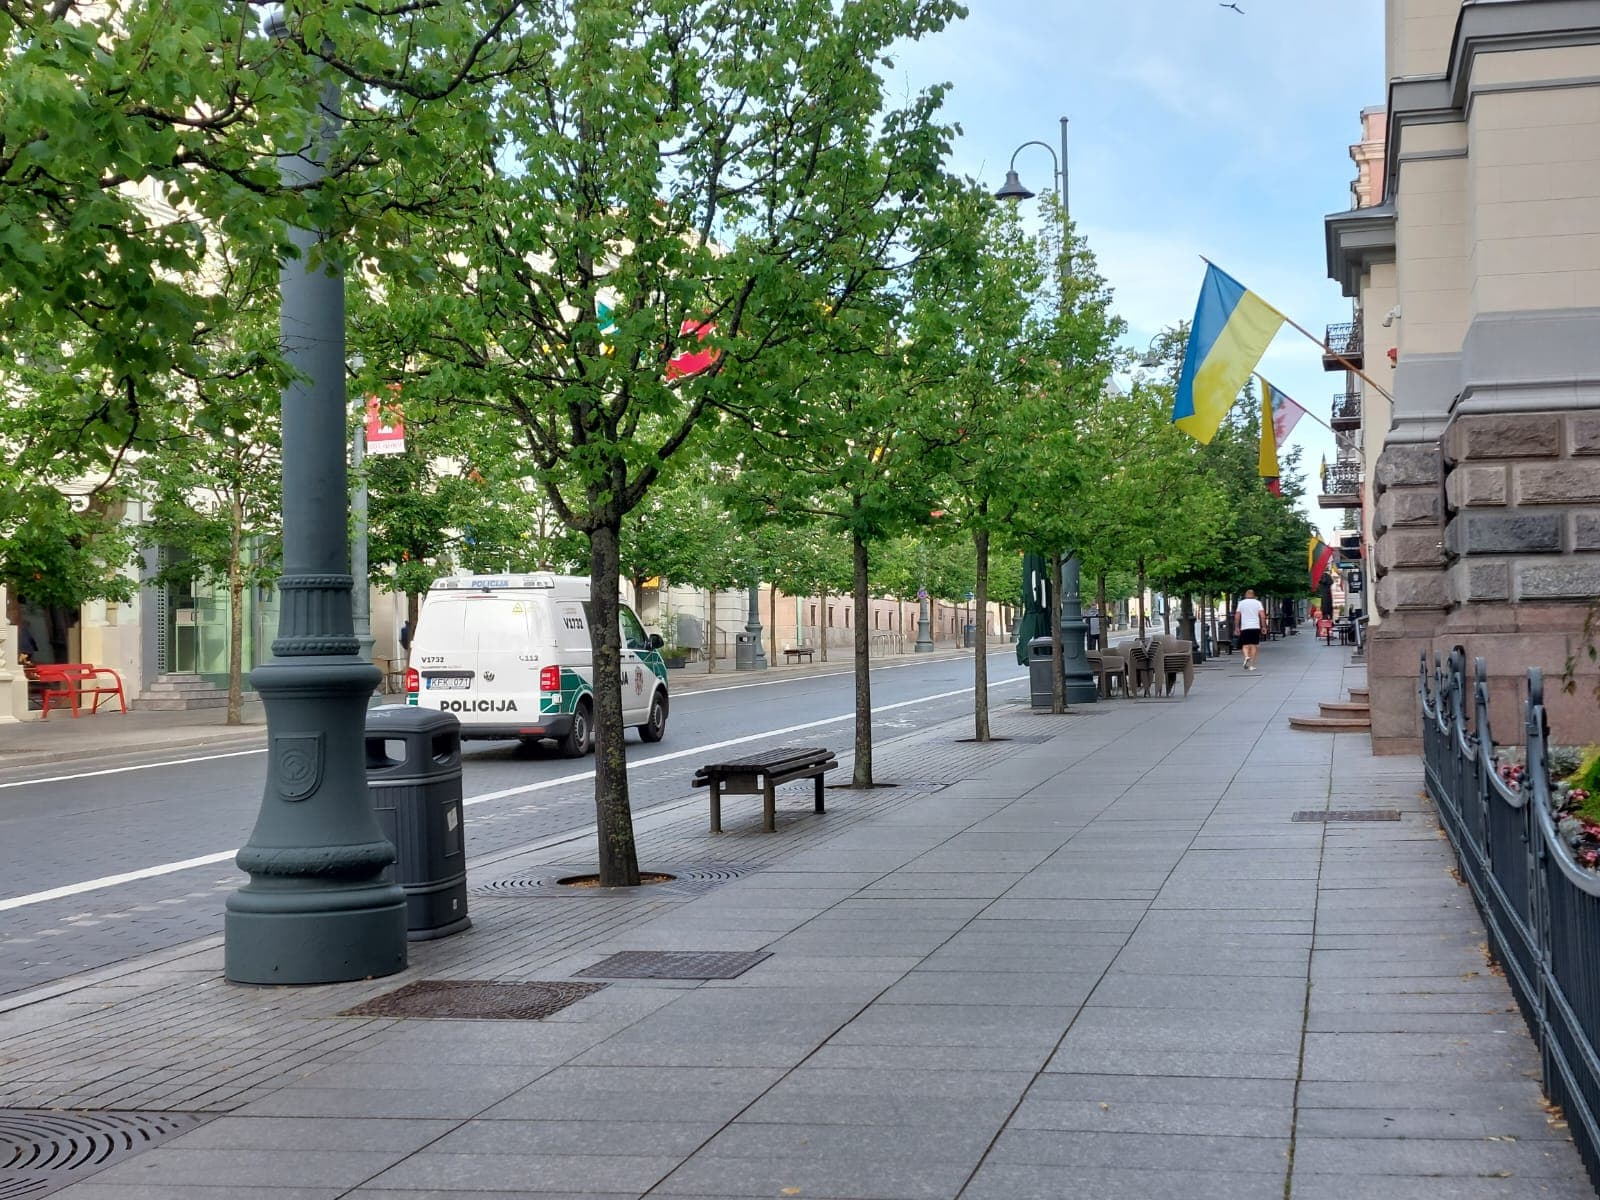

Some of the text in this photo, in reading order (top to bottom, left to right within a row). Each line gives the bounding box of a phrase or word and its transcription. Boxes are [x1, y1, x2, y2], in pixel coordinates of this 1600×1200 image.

[471, 579, 509, 588] POLICIJA
[563, 617, 584, 630] V1732
[453, 678, 469, 687] 071
[441, 700, 517, 712] POLICIJA
